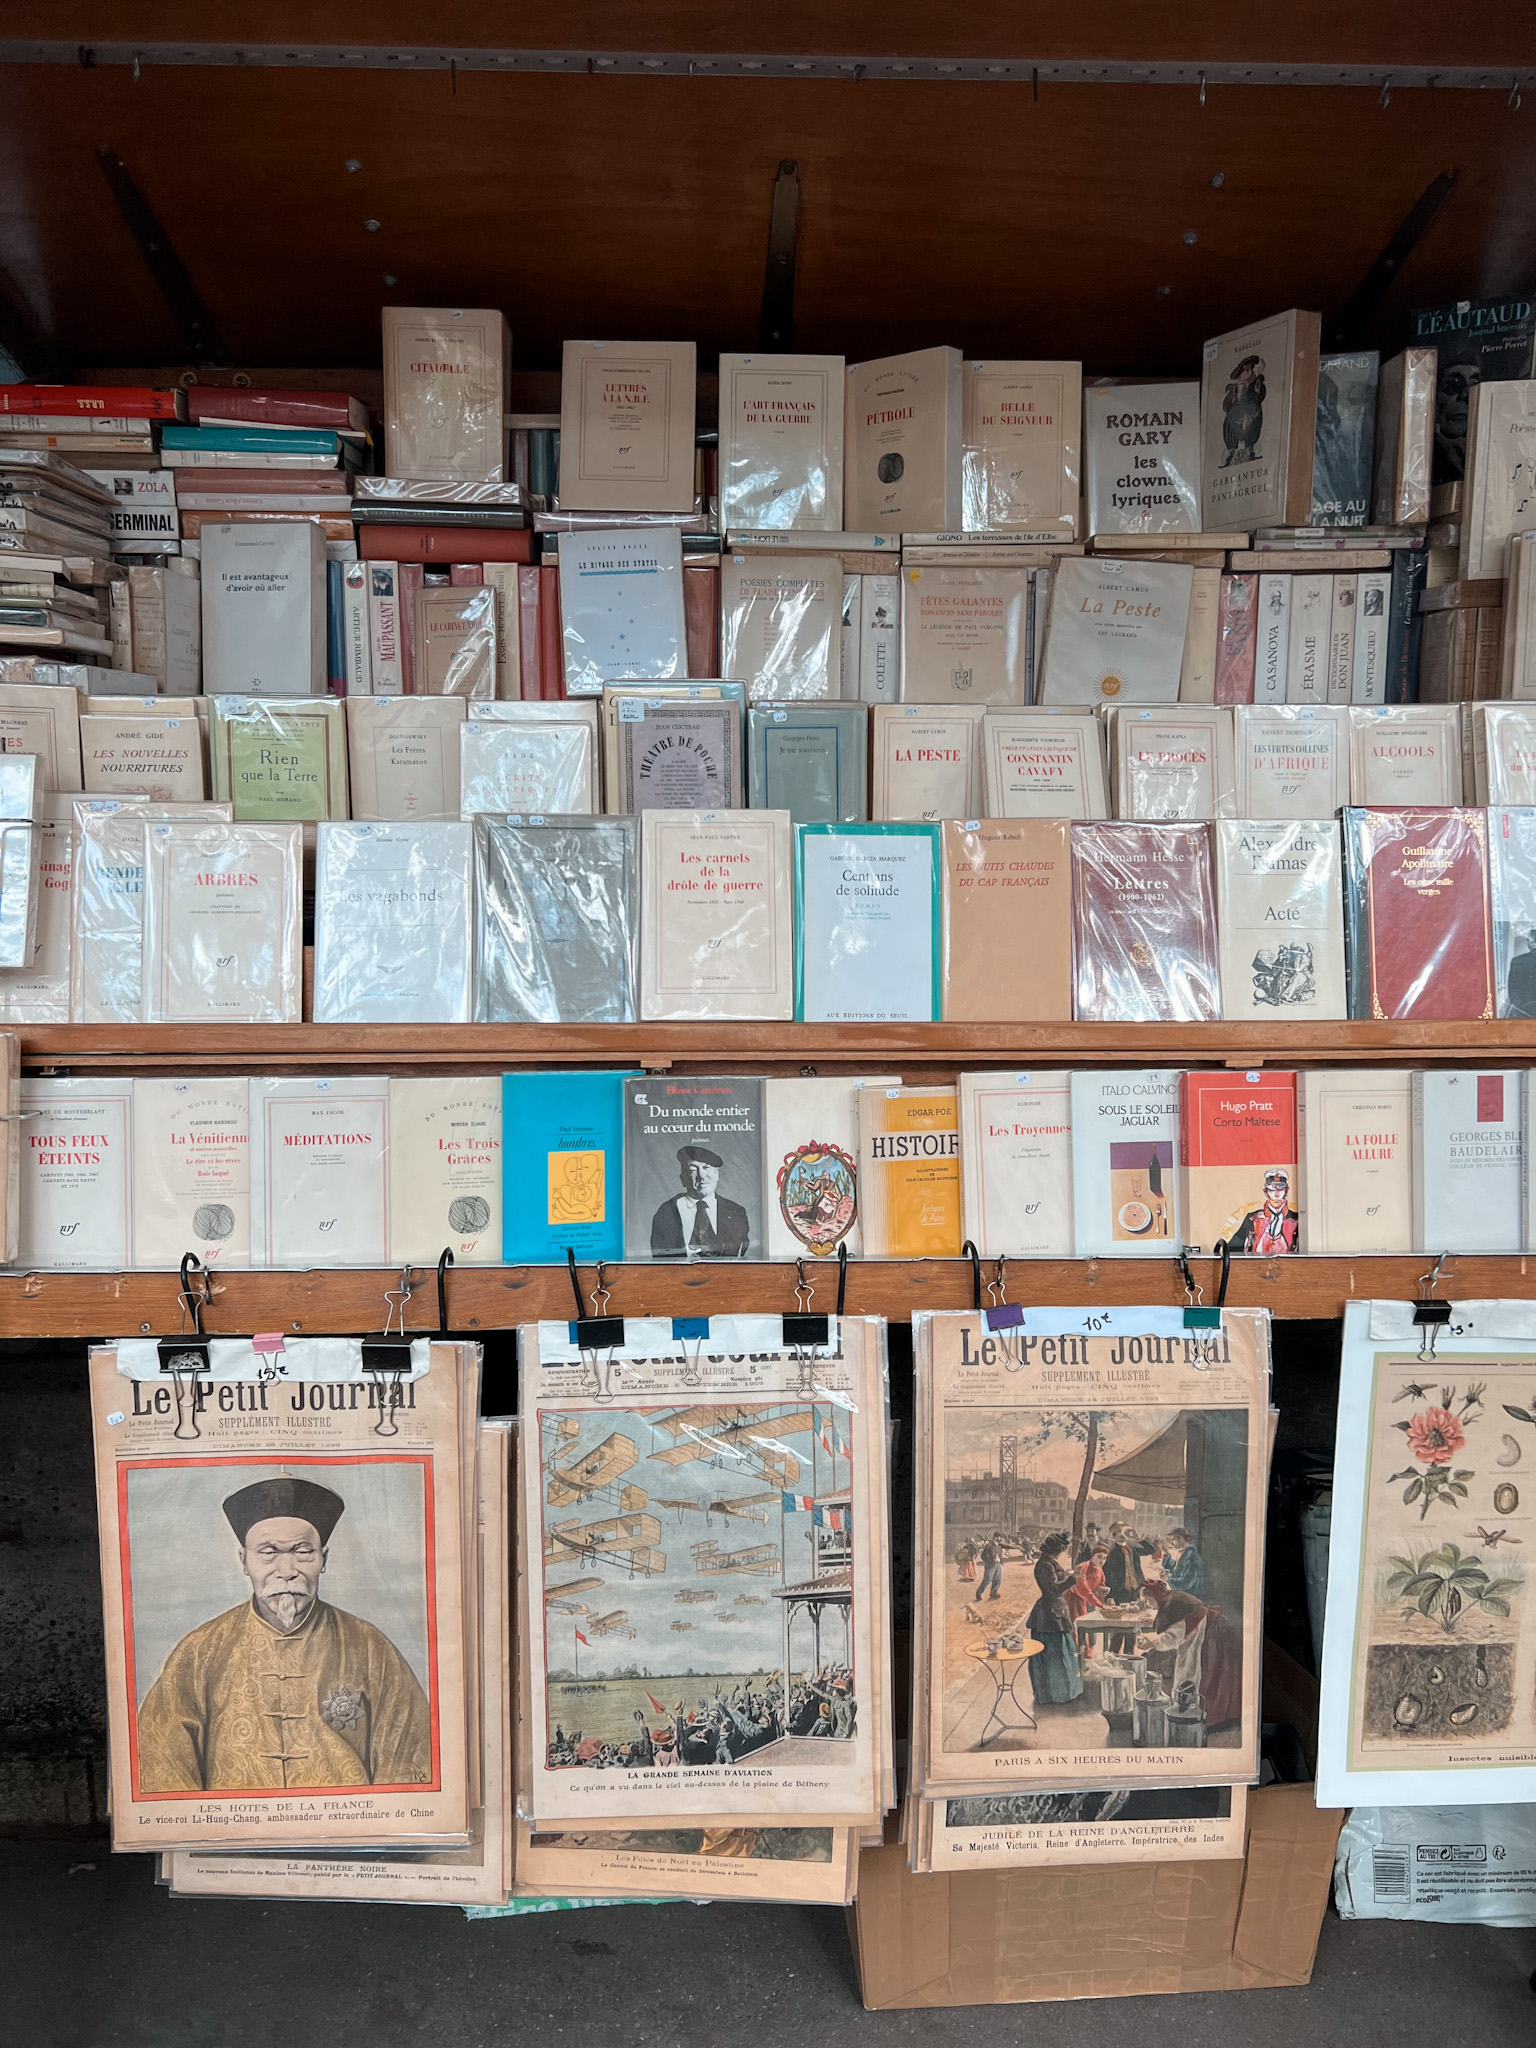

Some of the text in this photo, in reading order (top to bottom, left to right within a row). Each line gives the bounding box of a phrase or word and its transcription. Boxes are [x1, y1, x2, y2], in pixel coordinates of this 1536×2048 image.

[1417, 301, 1530, 336] LÉAUTAUD
[1481, 345, 1503, 353] Pierre
[410, 362, 469, 374] CITADELLE
[867, 406, 915, 425] PÉTROLE
[1106, 411, 1183, 428] ROMAIN
[1119, 431, 1172, 446] GARY
[1134, 456, 1157, 469] les
[1117, 475, 1175, 487] clowns
[1213, 468, 1268, 487] GARGANTUA
[138, 481, 169, 493] ZOLA
[1212, 484, 1268, 503] PANTAGRUEL
[1112, 493, 1180, 509] lyriques
[244, 573, 289, 581] avantageux
[226, 584, 253, 592] d'avoir
[255, 584, 265, 592] où
[1080, 598, 1161, 618] La Peste
[380, 601, 396, 662] MAUPASSANT
[1267, 625, 1279, 691] CASANOVA
[1303, 636, 1316, 691] ÉRASME
[1338, 633, 1350, 690] DON JUAN
[1365, 630, 1375, 698] MONTESQUIEU
[876, 642, 886, 690] COLETTE
[116, 731, 141, 739] ANDRÉ
[93, 749, 188, 758] LES NOUVELLES
[260, 750, 299, 765] Rien
[895, 749, 961, 761] LA PESTE
[1371, 746, 1436, 757] ALCOOLS
[640, 736, 717, 780] THÉÂTRE DE POCHE
[1254, 757, 1329, 770] D'AFRIQUE
[101, 764, 183, 773] NOURRITURES
[241, 768, 318, 783] que la Terre
[681, 853, 750, 863] Les carnets
[700, 866, 730, 877] de la
[843, 870, 893, 882] Cent ans
[194, 874, 258, 886] ARBRES
[668, 880, 763, 893] drôle de guerre
[836, 885, 899, 896] de solitude
[1265, 906, 1300, 921] Acté
[1102, 1084, 1176, 1096] ITALO CALVINO
[650, 1105, 749, 1117] Du monde entier
[934, 1108, 951, 1116] POE
[1099, 1104, 1180, 1115] SOUS LE SOLEIL
[1221, 1101, 1273, 1113] Hugo Pratt
[644, 1121, 755, 1133] au cœur du monde
[1120, 1116, 1159, 1126] JAGUAR
[1213, 1117, 1280, 1126] Corto Maltese
[990, 1124, 1070, 1137] Les Troyennes
[28, 1135, 109, 1148] TOUS FEUX
[284, 1133, 371, 1146] MÉDITATIONS
[558, 1137, 596, 1149] hombres
[38, 1151, 100, 1165] ÉTEINTS
[132, 1381, 171, 1416] Le
[196, 1381, 268, 1413] Petit
[218, 1416, 331, 1428] SUPPLÉMENT ILLUSTRÉ
[995, 1757, 1031, 1766] PARIS
[1074, 1756, 1121, 1764] HEURES
[1127, 1756, 1142, 1764] DU
[1147, 1756, 1184, 1764] MATIN
[643, 1771, 679, 1779] GRANDE
[584, 1784, 606, 1792] qu'on
[754, 1780, 779, 1788] plaine
[796, 1780, 829, 1788] Bétheny
[200, 1801, 373, 1813] LES HOTES DE LA FRANCE
[139, 1808, 434, 1825] Le vice-roi Li-Hung-Chang, ambassadeur extraordinaire de Chine
[982, 1829, 1022, 1840] JUBILÉ
[1049, 1829, 1063, 1837] LA
[1070, 1828, 1104, 1836] REINE
[1110, 1825, 1194, 1834] D'ANGLETERRE
[969, 1842, 999, 1852] Majesté
[1006, 1840, 1039, 1849] Victoria,
[1046, 1840, 1068, 1848] Reine
[1075, 1838, 1126, 1847] d'Angleterre,
[1132, 1836, 1178, 1845] Impératrice
[1184, 1835, 1197, 1843] des
[1203, 1834, 1224, 1842] Indes
